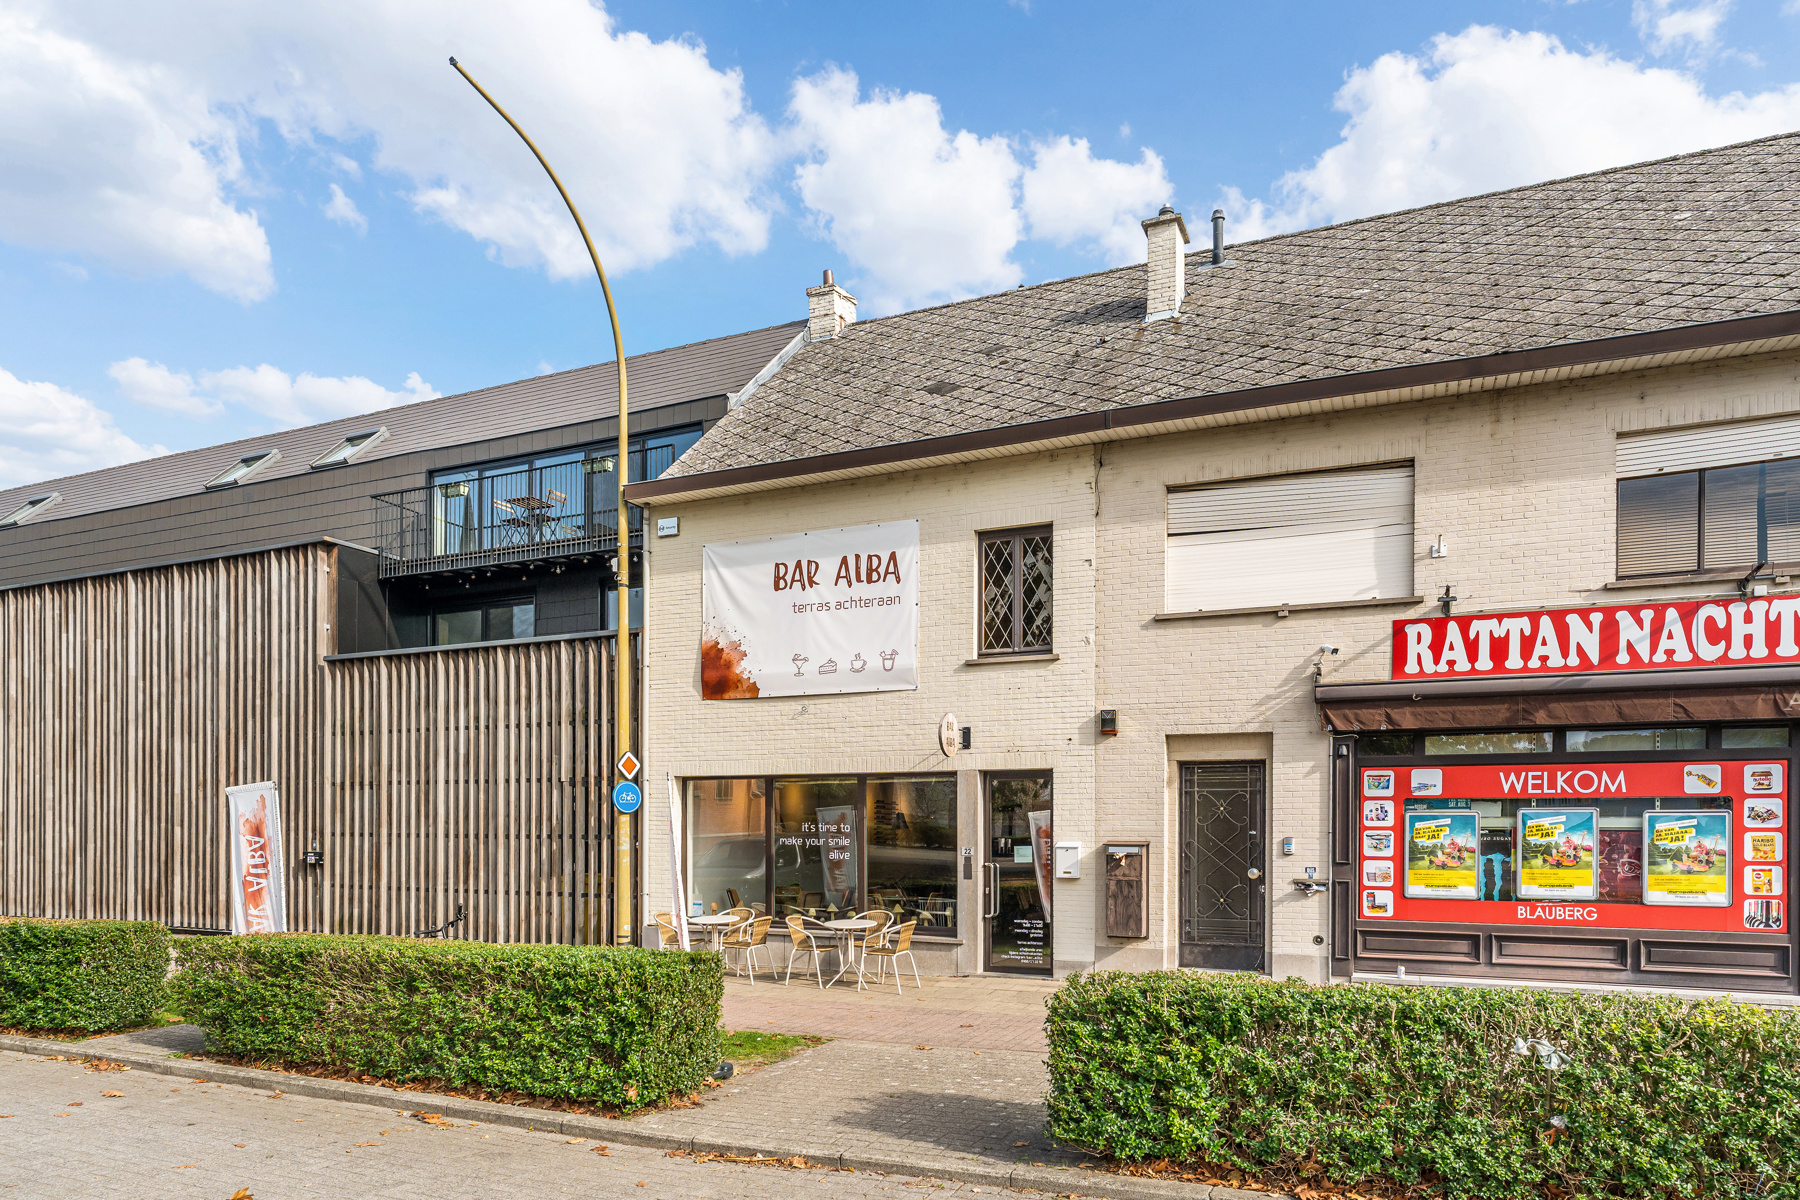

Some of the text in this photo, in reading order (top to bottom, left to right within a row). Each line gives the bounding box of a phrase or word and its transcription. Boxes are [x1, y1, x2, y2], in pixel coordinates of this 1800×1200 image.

[774, 551, 901, 592] BAR ALBA
[792, 595, 900, 614] terras achteraan
[1404, 612, 1604, 674] RATTAN
[1500, 770, 1626, 794] WELKOM
[802, 822, 850, 832] it's time to
[780, 836, 850, 848] make your smile
[829, 850, 850, 859] alive
[1518, 906, 1598, 920] BLAUBERG
